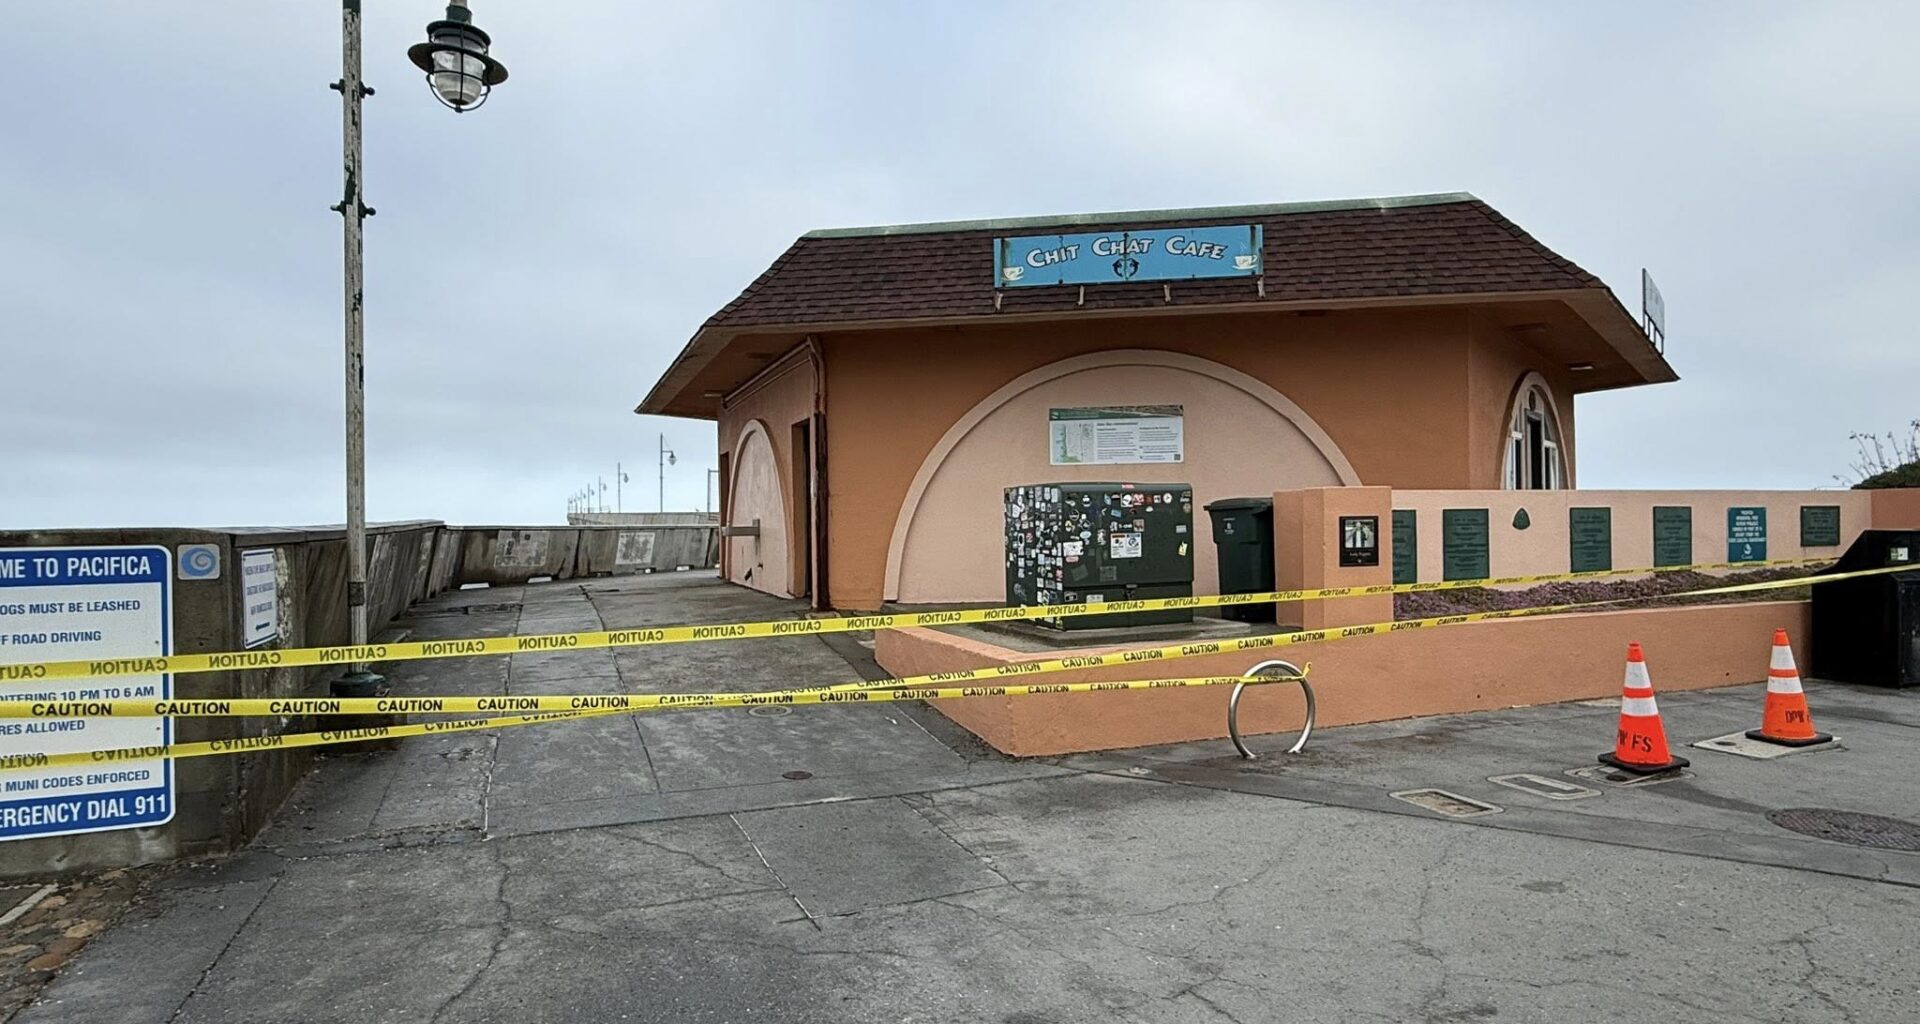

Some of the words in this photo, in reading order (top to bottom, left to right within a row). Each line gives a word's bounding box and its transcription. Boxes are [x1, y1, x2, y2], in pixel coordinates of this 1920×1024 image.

[1026, 244, 1080, 268] CHIT
[1091, 237, 1154, 257] CHAT
[1165, 235, 1229, 260] CAFE
[33, 558, 59, 578] TO
[67, 556, 152, 577] PACIFICA
[29, 603, 64, 614] MUST
[68, 602, 84, 613] BE
[87, 600, 141, 612] LEASHED
[12, 633, 47, 645] ROAD
[51, 631, 102, 643] DRIVING
[929, 670, 975, 681] CAUTION
[997, 663, 1041, 675] CAUTION
[1062, 656, 1104, 668] CAUTION
[1123, 650, 1163, 661] CAUTION
[1182, 644, 1219, 655] CAUTION
[1238, 638, 1274, 649] CAUTION
[1291, 632, 1325, 643] CAUTION
[1342, 626, 1375, 637] CAUTION
[1390, 621, 1423, 631] CAUTION
[32, 703, 113, 716] CAUTION
[154, 702, 230, 715] CAUTION
[270, 701, 340, 714] CAUTION
[377, 700, 443, 712] CAUTION
[477, 698, 539, 710] CAUTION
[571, 697, 629, 709] CAUTION
[820, 692, 868, 702] CAUTION
[893, 690, 939, 699] CAUTION
[962, 688, 1006, 697] CAUTION
[1028, 685, 1069, 694] CAUTION
[62, 690, 76, 701] 10
[80, 689, 100, 700] PM
[105, 688, 121, 699] TO
[124, 688, 131, 698] 6
[135, 686, 155, 696] AM
[25, 720, 85, 733] ALLOWED
[1631, 733, 1652, 752] FS
[5, 780, 39, 792] MUNI
[43, 776, 83, 789] CODES
[87, 770, 150, 785] ENFORCED
[87, 798, 130, 820] DIAL
[135, 794, 166, 815] 911
